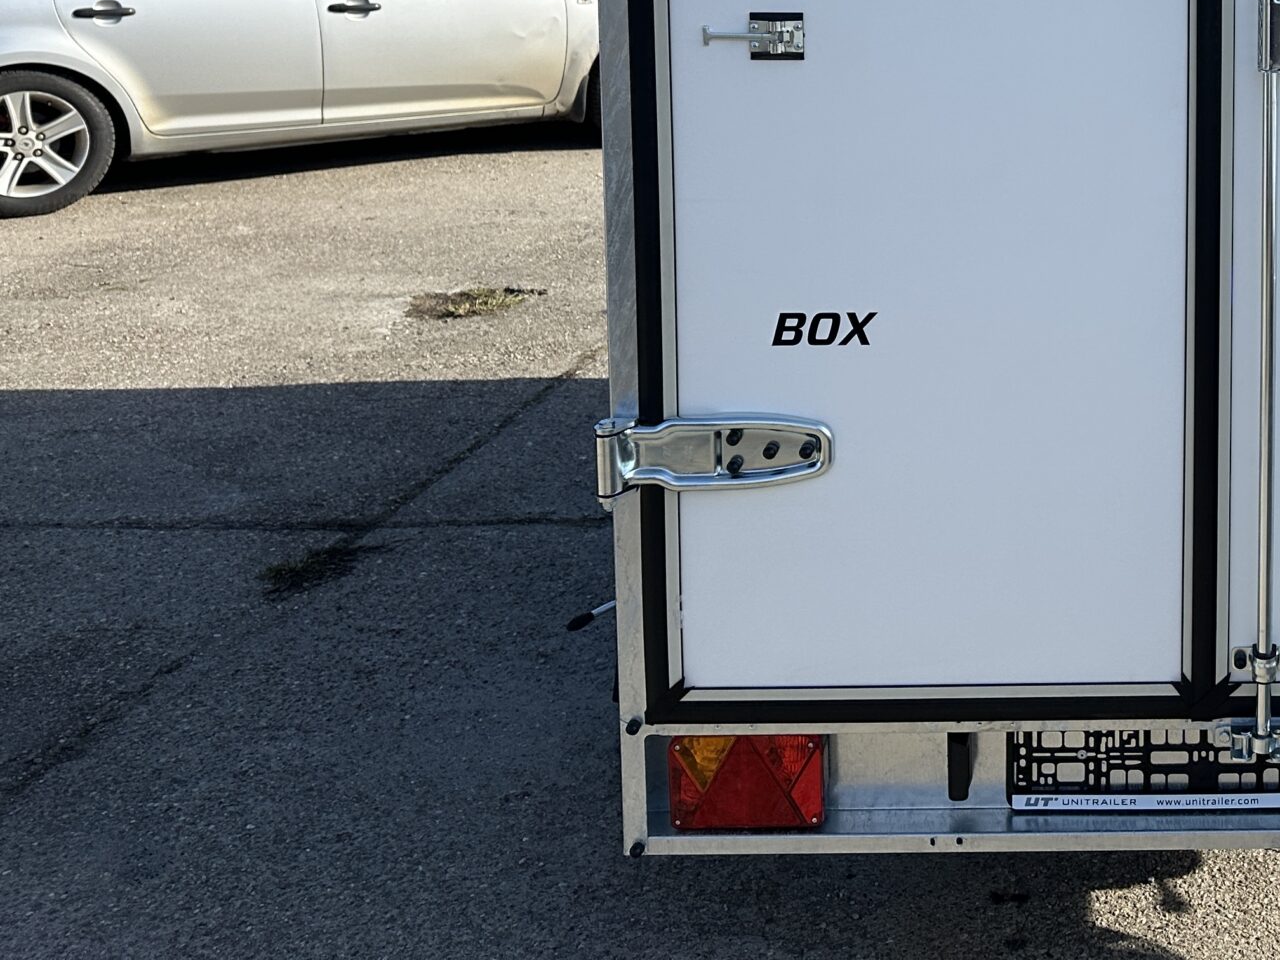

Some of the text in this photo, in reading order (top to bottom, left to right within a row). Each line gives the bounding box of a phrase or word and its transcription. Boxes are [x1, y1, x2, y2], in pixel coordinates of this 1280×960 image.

[771, 311, 878, 347] BOX
[1061, 798, 1137, 806] UNITRAILER
[1156, 796, 1259, 806] www.unitrailer.com
